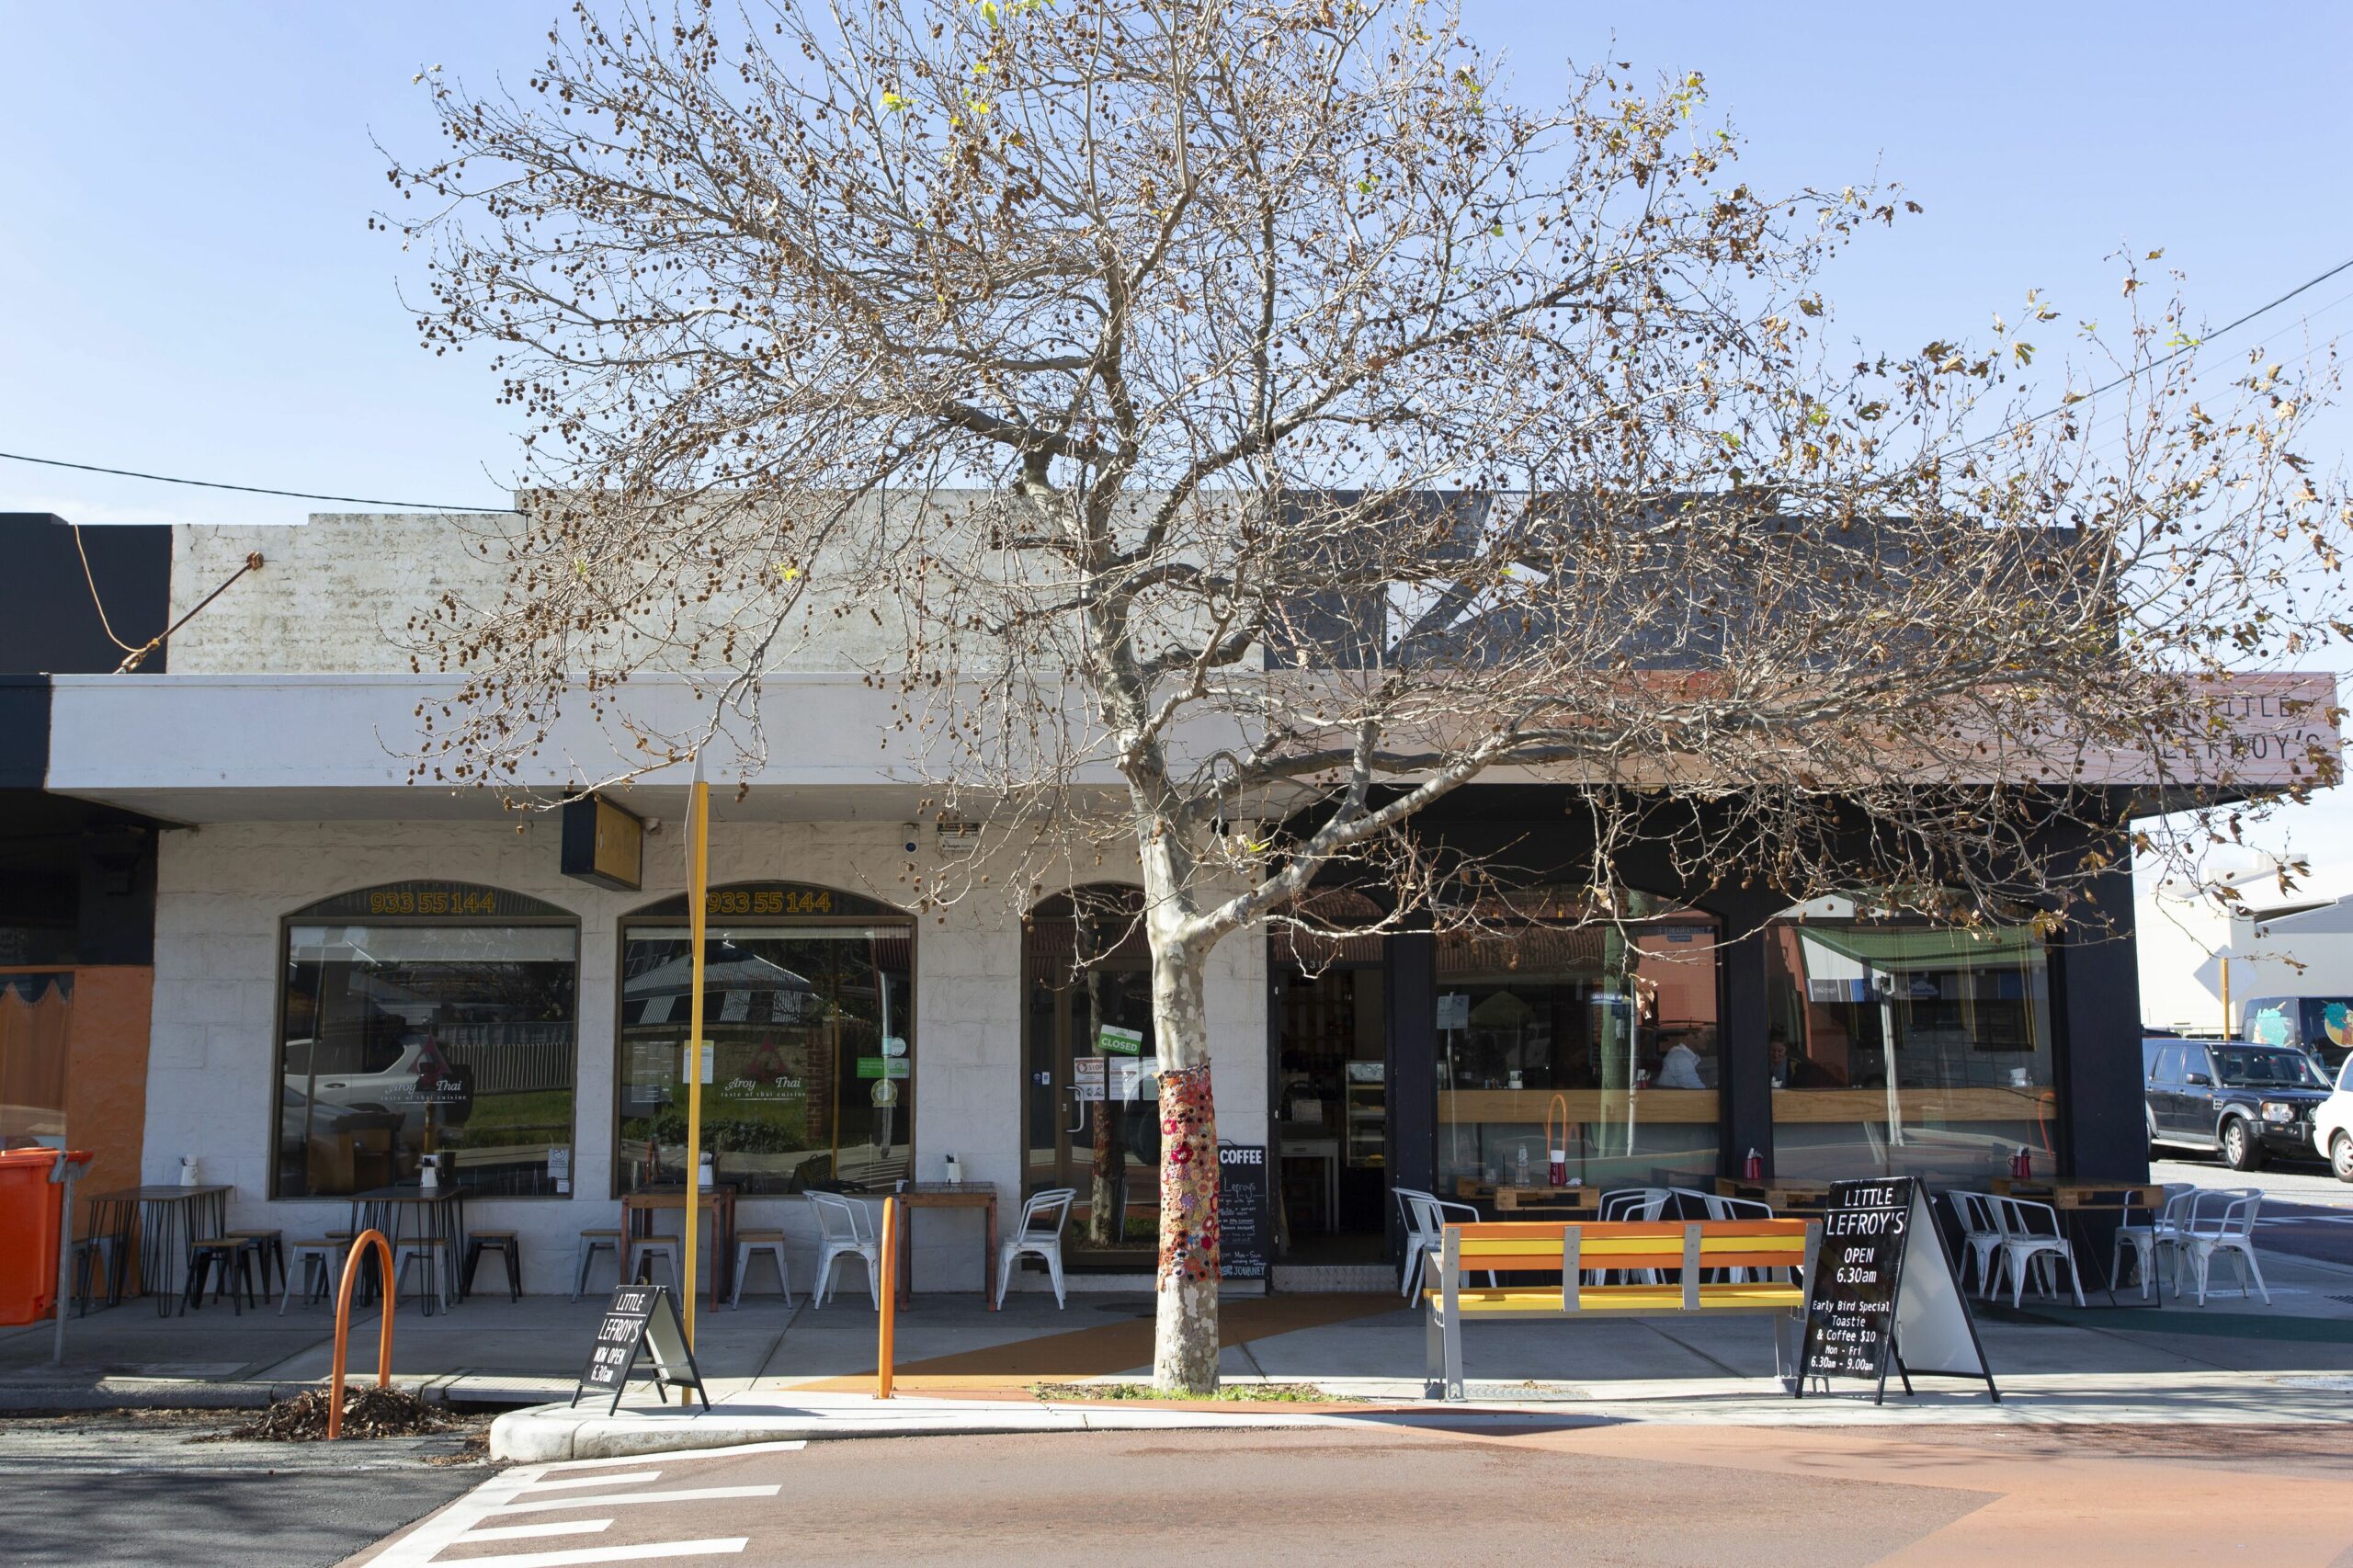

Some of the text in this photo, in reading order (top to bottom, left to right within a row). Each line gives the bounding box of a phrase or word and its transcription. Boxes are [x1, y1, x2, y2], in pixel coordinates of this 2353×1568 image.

[1101, 1037, 1138, 1051] CLOSED
[385, 1080, 461, 1094] Aroy Thai
[724, 1076, 801, 1091] Aroy Thai
[1219, 1149, 1263, 1165] COFFEE
[1844, 1187, 1893, 1207] LITTLE
[1826, 1211, 1904, 1236] LEFROY'S
[1844, 1247, 1874, 1264] OPEN
[1233, 1266, 1266, 1277] JOURNEY
[1836, 1267, 1877, 1283] 6.30am
[616, 1293, 645, 1312] LITTLE
[1812, 1300, 1890, 1312] Early Bird Special
[1832, 1315, 1866, 1327] Toastie
[597, 1318, 643, 1343] LEFROY'S
[1816, 1329, 1876, 1342] & Coffee $10
[593, 1346, 627, 1365] NOW OPEN
[1825, 1345, 1838, 1355] Mon
[1848, 1346, 1861, 1356] Fri
[1811, 1356, 1836, 1368] 6.30am
[1847, 1358, 1874, 1370] 9.00am
[591, 1364, 614, 1382] 6.30am
